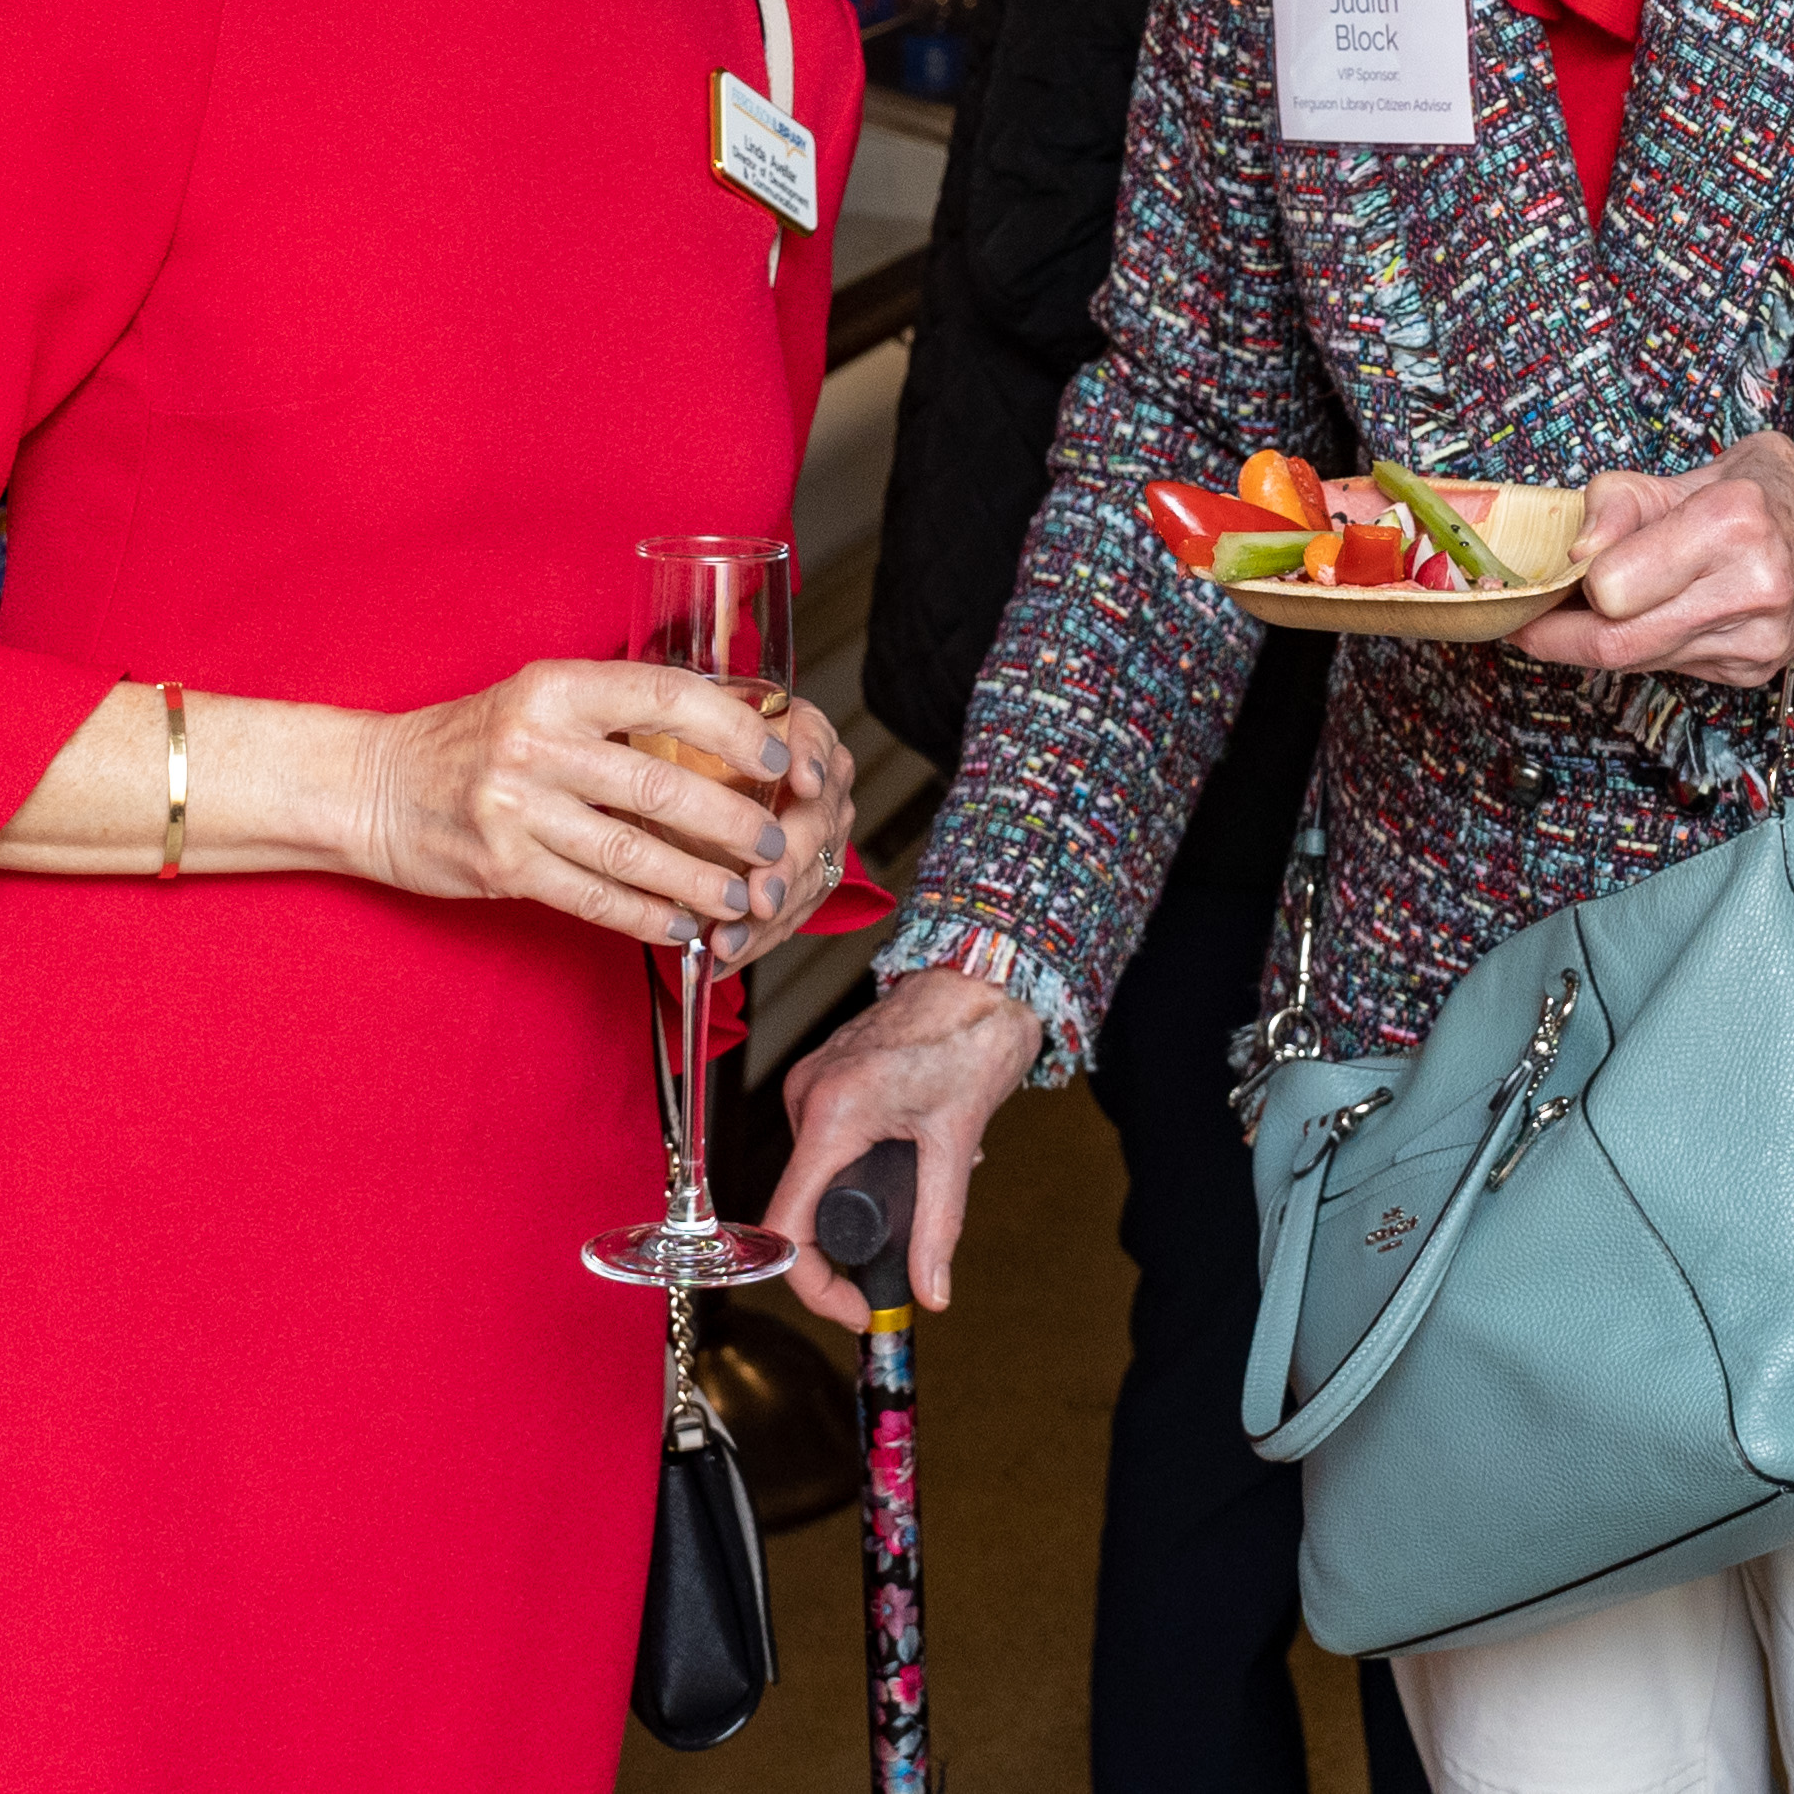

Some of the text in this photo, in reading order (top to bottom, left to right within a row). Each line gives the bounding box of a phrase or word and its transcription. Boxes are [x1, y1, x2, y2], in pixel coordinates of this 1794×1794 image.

[1335, 24, 1399, 52] Block
[1337, 68, 1355, 81] VIP
[1293, 96, 1453, 114] Ferguson Library Citizen Advisor
